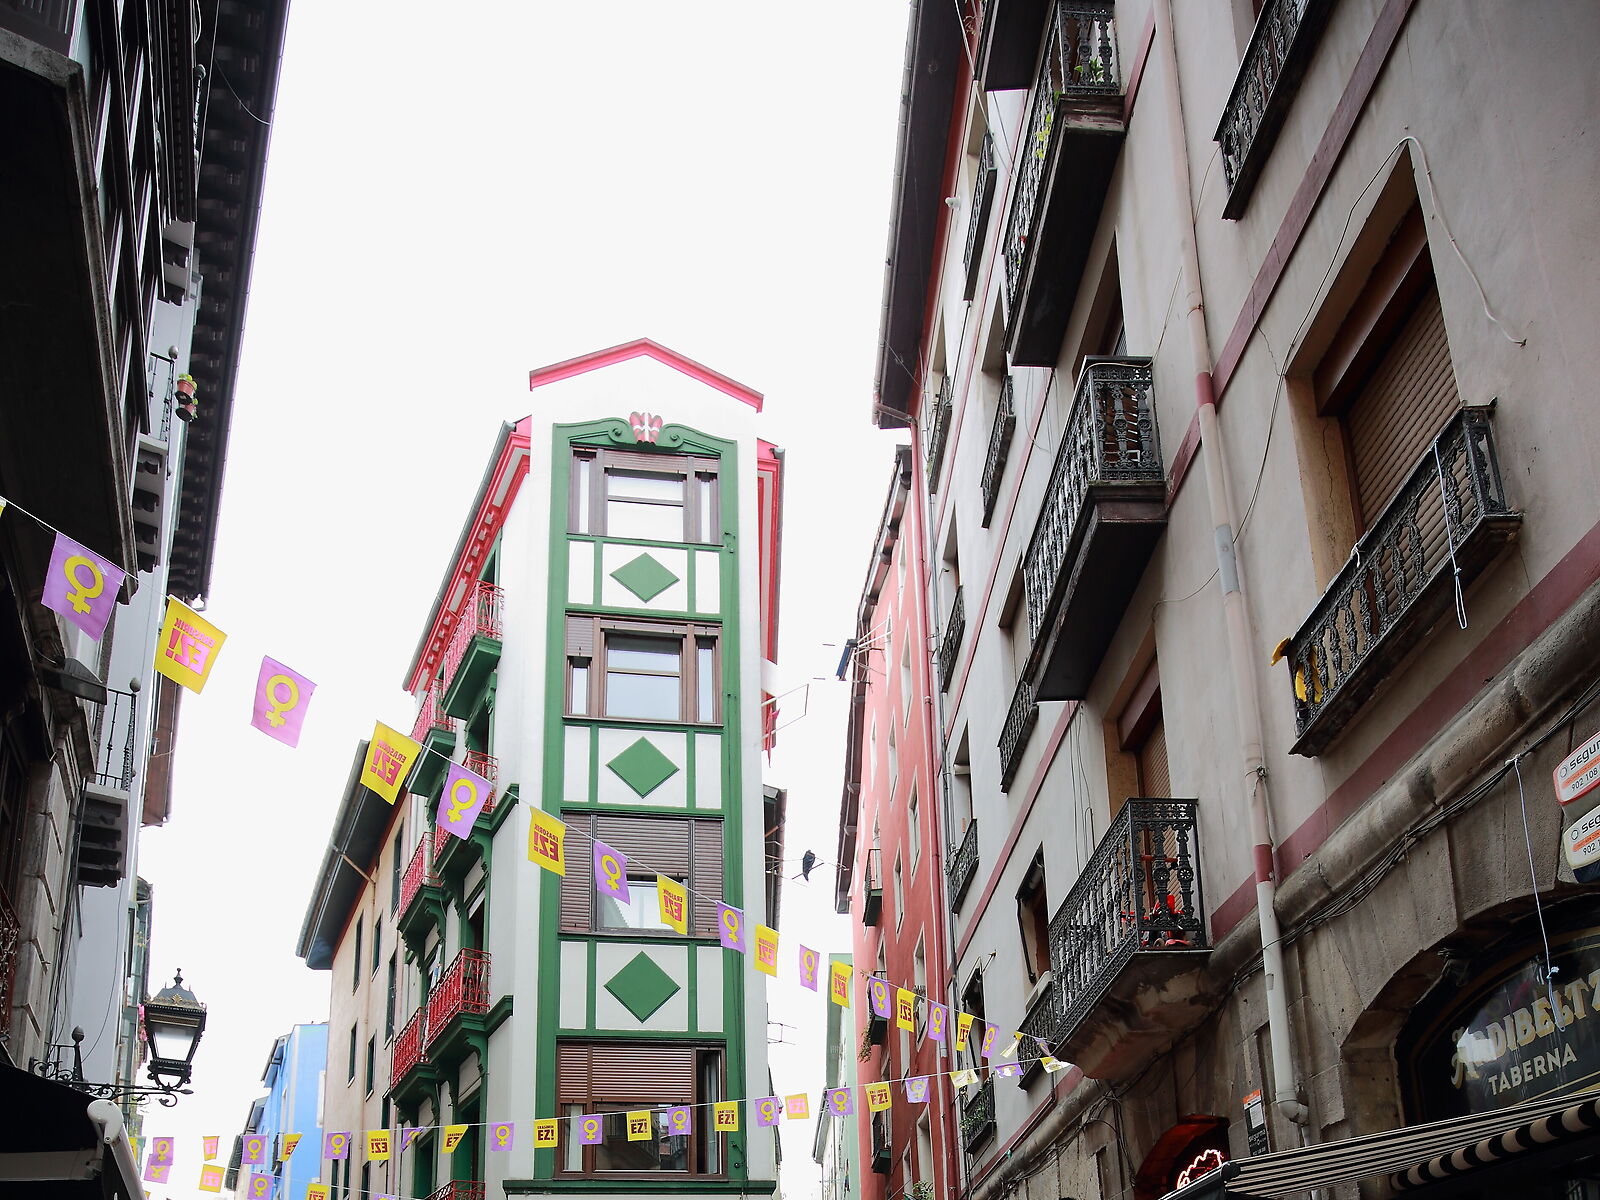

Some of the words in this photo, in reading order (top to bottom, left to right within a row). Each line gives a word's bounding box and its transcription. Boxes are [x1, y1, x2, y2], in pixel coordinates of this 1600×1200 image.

[1571, 778, 1584, 791] 902
[1585, 767, 1598, 780] 108
[1583, 842, 1596, 856] 902
[1488, 1042, 1578, 1096] TABERNA
[871, 1093, 888, 1105] EZ!
[717, 1113, 735, 1125] EZ!
[630, 1123, 648, 1134] EZ!
[537, 1129, 554, 1141] EZ!
